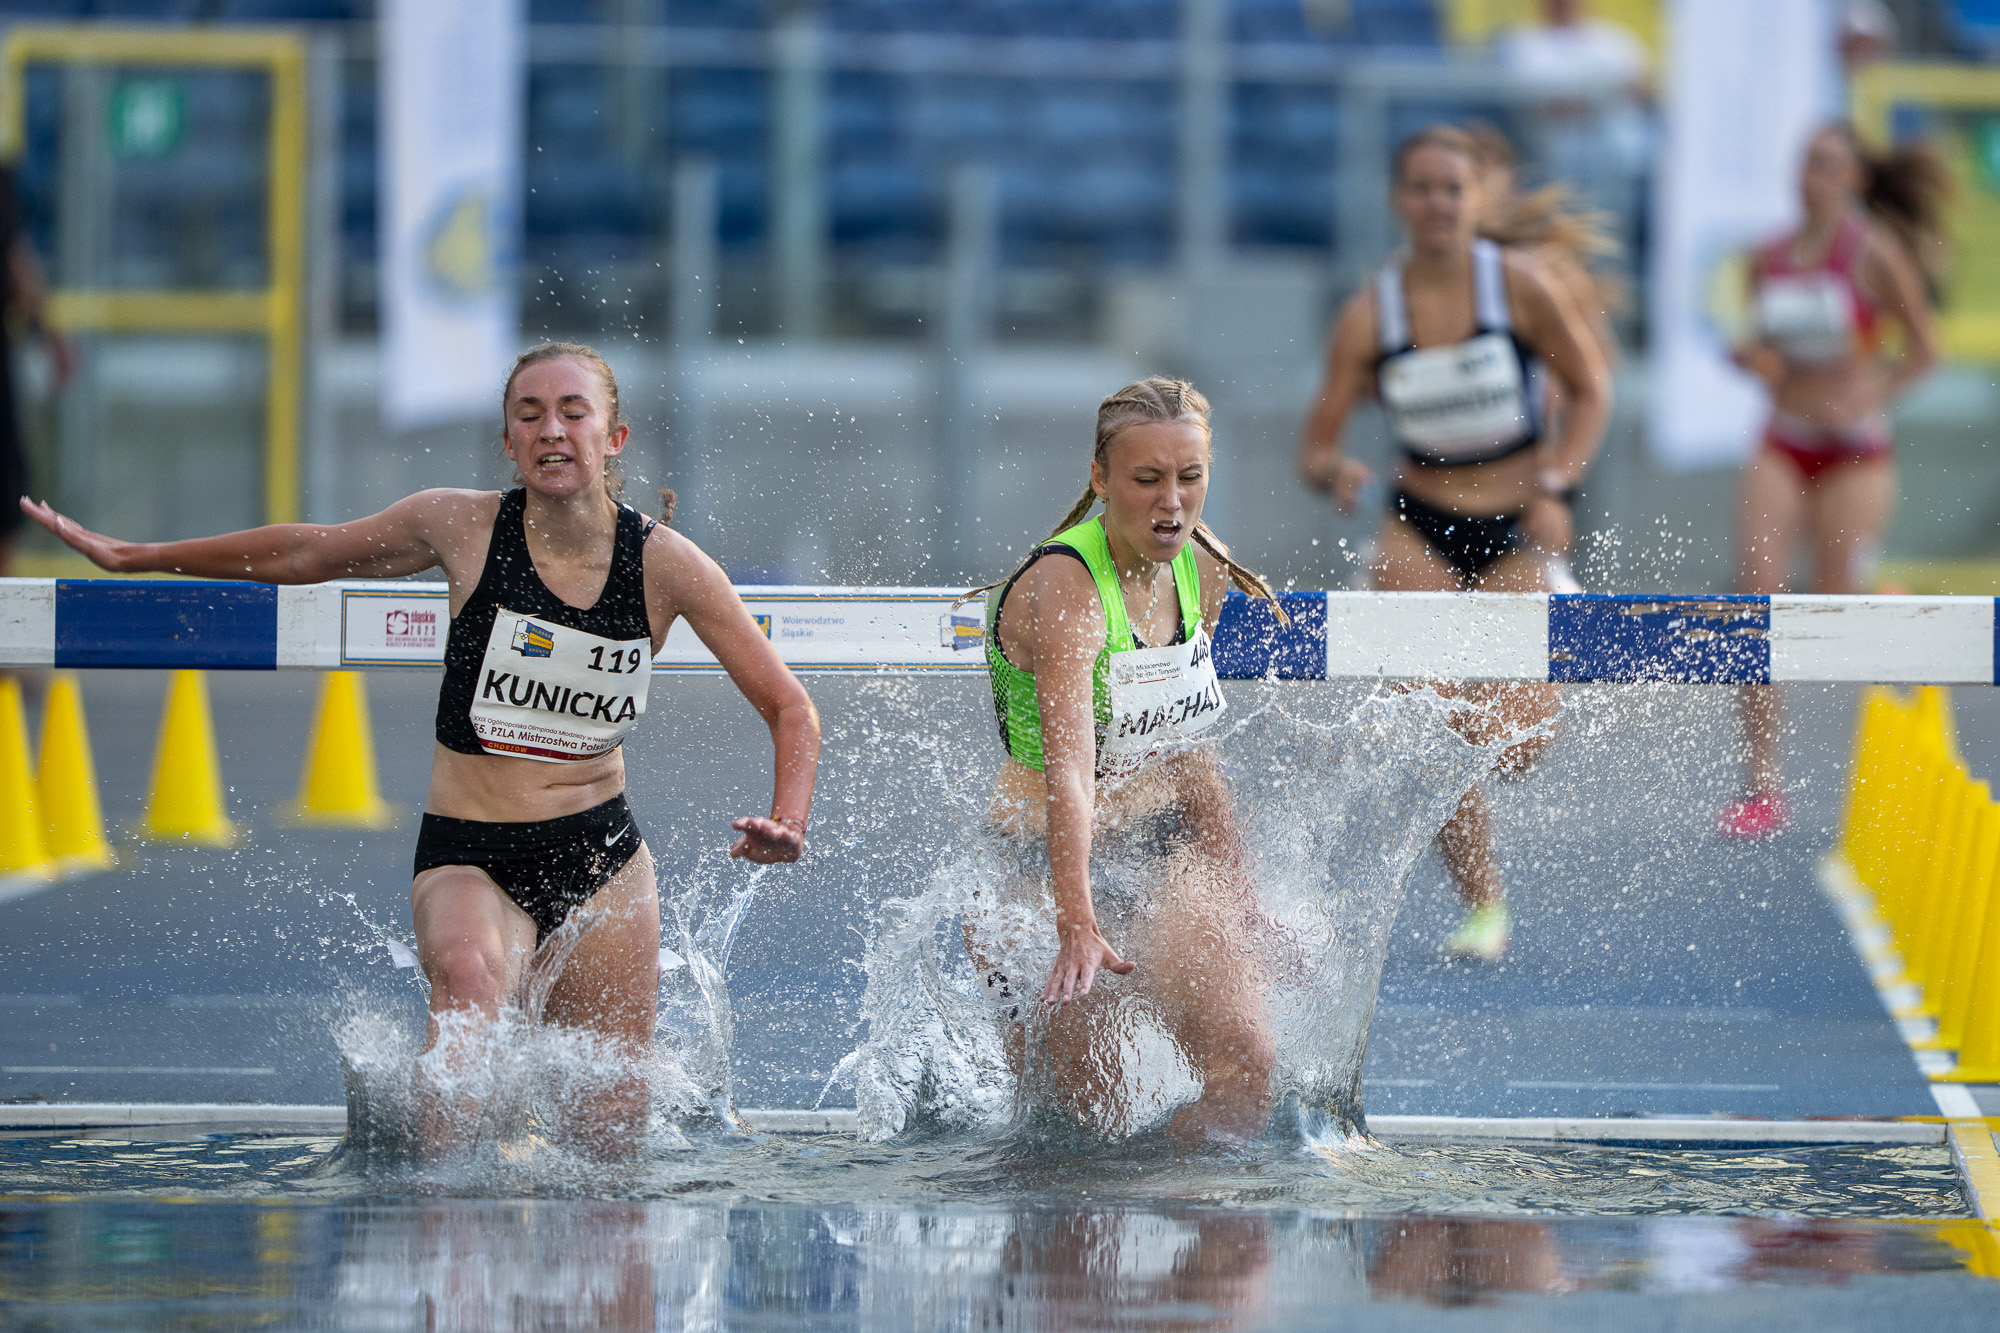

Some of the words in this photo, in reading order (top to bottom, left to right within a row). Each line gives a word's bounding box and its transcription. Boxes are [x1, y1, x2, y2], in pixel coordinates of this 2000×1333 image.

[587, 645, 641, 674] 119
[482, 669, 636, 723] KUNICKA
[487, 718, 527, 730] Ogólnopolska
[528, 724, 557, 735] Olimpiada
[558, 730, 586, 741] Młodzieży
[490, 726, 515, 739] PZLA
[517, 731, 577, 750] Mistrzostwa
[580, 742, 609, 751] Polski
[487, 741, 528, 753] CHORZÓW
